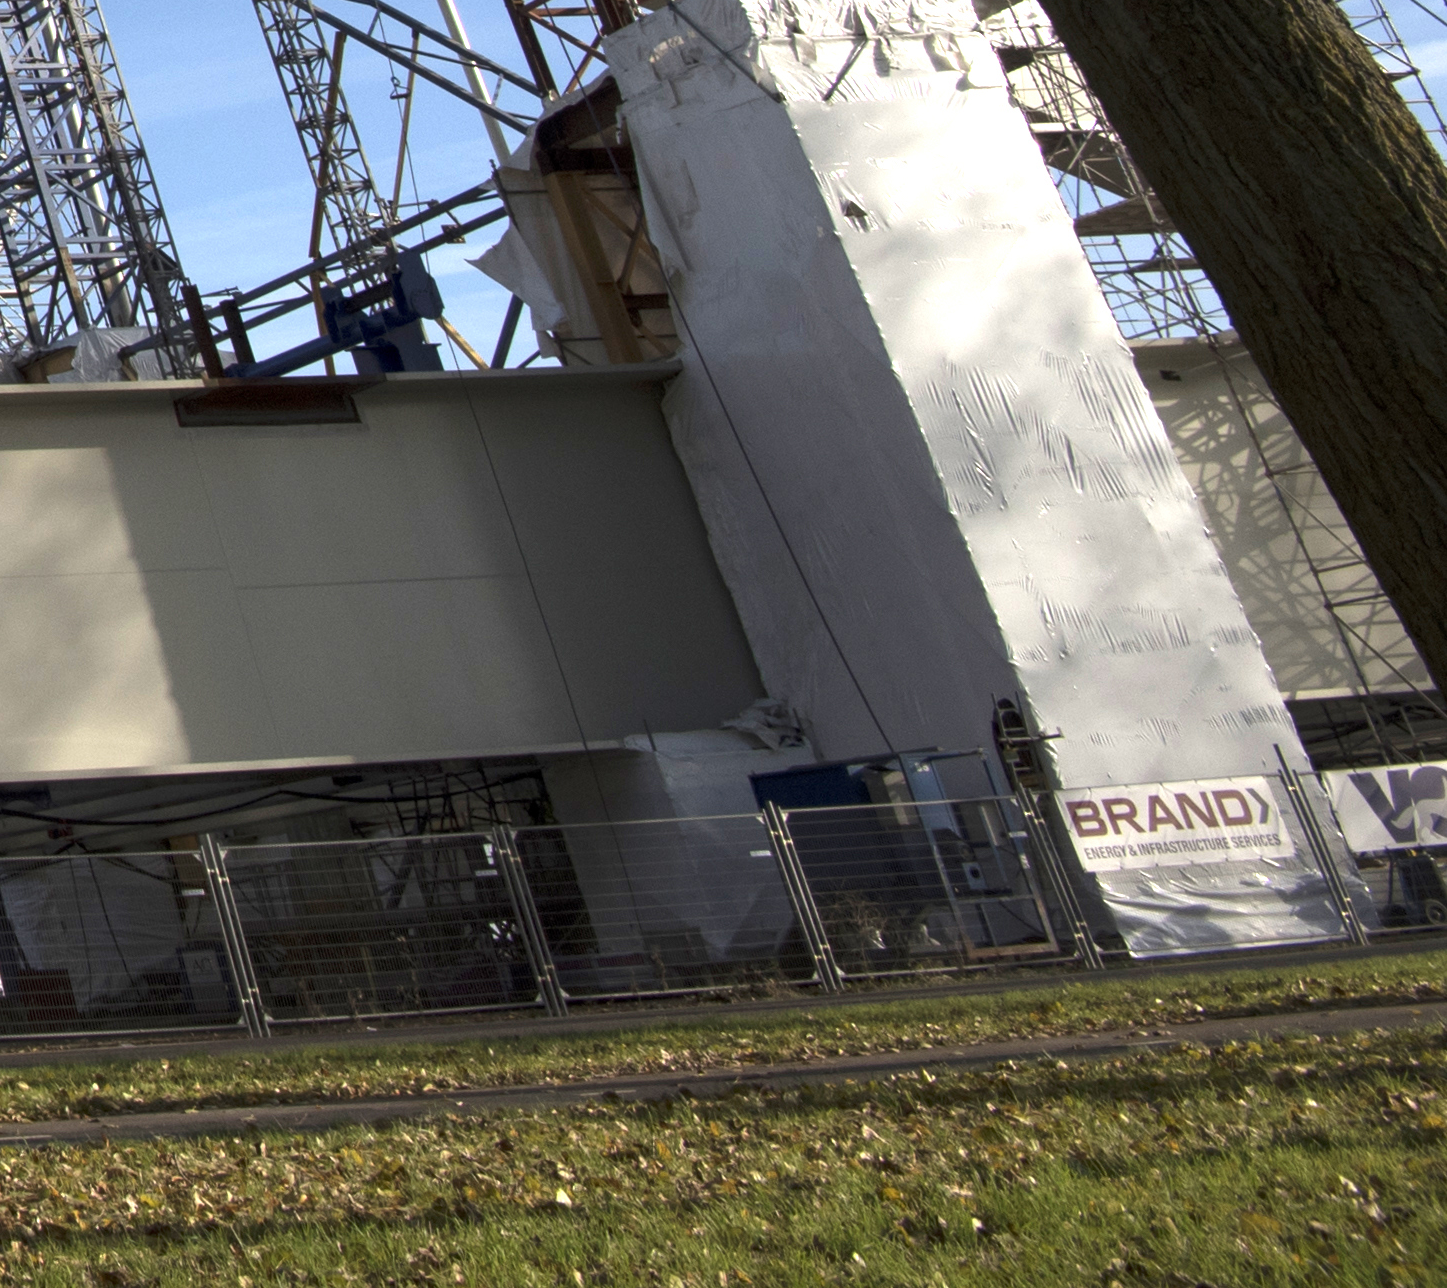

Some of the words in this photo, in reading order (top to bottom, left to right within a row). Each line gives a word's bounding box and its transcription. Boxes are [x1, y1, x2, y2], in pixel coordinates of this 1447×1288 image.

[1068, 789, 1253, 837] BRAND
[1084, 846, 1127, 860] ENERGY
[1128, 844, 1137, 856] &
[1138, 837, 1230, 855] INFRASTRUCTURE
[1231, 833, 1281, 849] SERVICES
